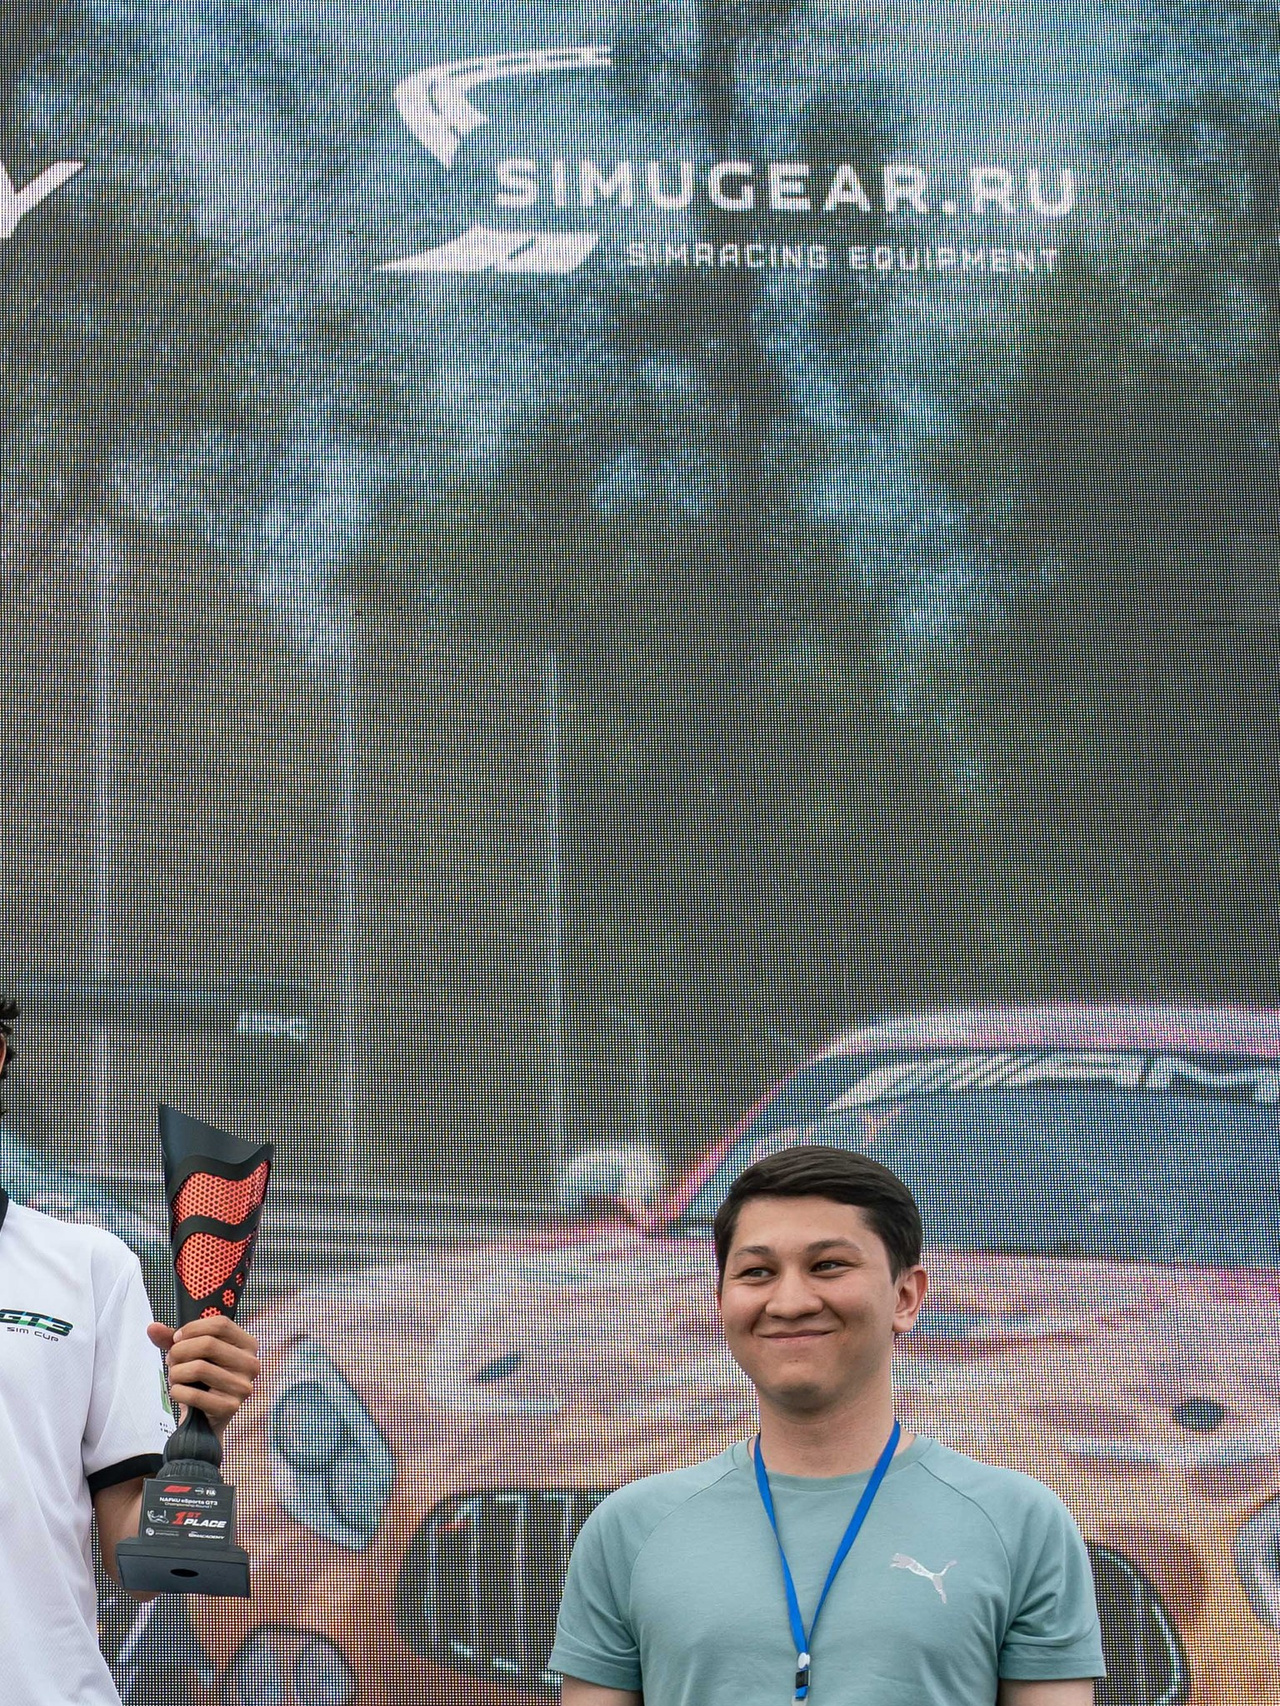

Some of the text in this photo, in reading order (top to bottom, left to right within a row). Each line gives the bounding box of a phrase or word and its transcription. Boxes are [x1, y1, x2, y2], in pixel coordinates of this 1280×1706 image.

[495, 157, 1076, 217] SIMUGEAR.RU
[628, 242, 1058, 274] SIMRACING EQUIPMENT
[6, 1326, 59, 1342] SIM CUP
[180, 1497, 205, 1505] eSports
[205, 1498, 218, 1506] GT3
[183, 1518, 227, 1528] PLACE
